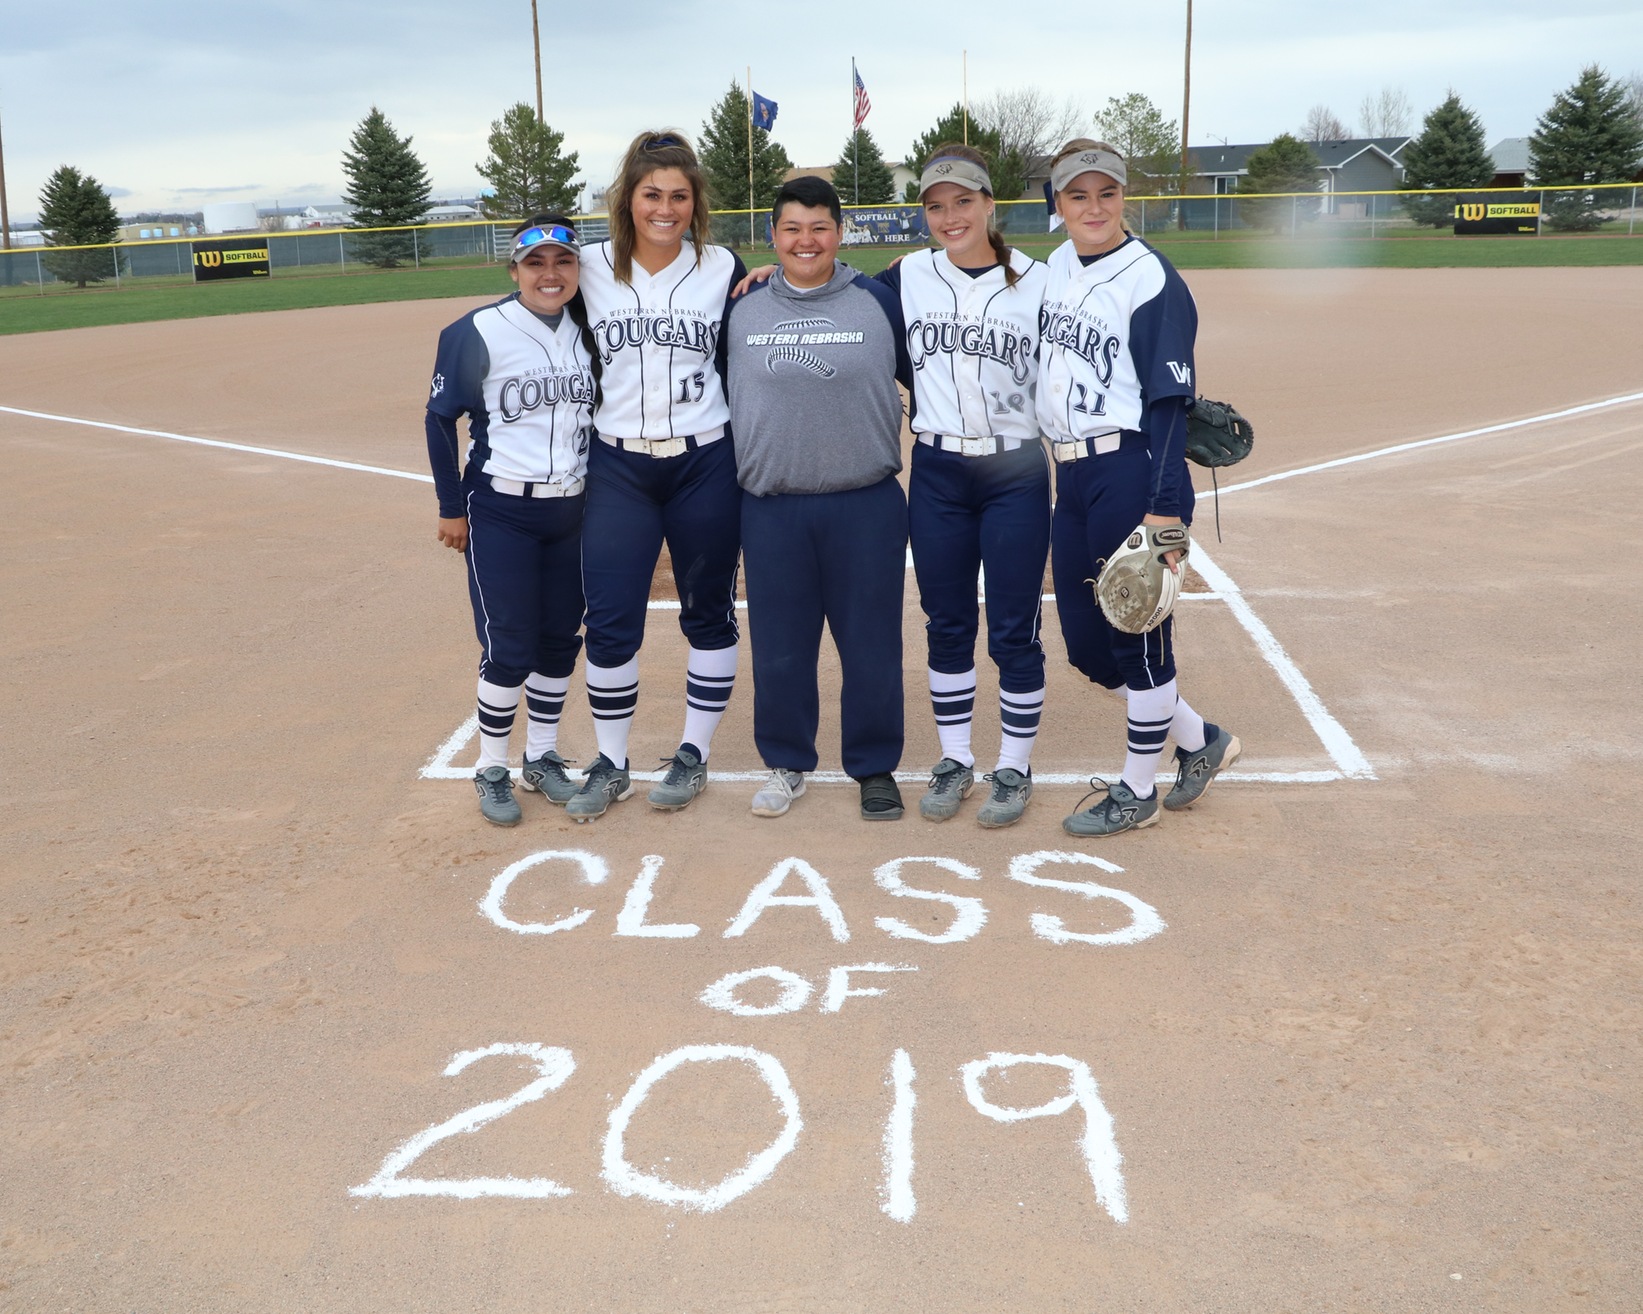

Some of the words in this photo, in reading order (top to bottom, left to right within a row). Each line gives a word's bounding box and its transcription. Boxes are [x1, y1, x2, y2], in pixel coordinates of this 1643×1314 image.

[1490, 207, 1536, 215] SOFTBALL
[885, 234, 910, 242] HERE
[226, 252, 266, 261] SOFTBALL
[661, 308, 708, 320] NEBRASKA
[975, 315, 1021, 334] NEBRASKA
[746, 333, 799, 346] WESTERN
[800, 331, 865, 345] NEBRASKA
[907, 317, 1032, 386] COUGARS
[1040, 309, 1121, 389] OUGARS
[500, 372, 595, 423] COUGA
[676, 371, 704, 404] 15
[478, 848, 1168, 947] CLASS
[699, 962, 919, 1016] OF
[347, 1042, 1130, 1224] 2019
